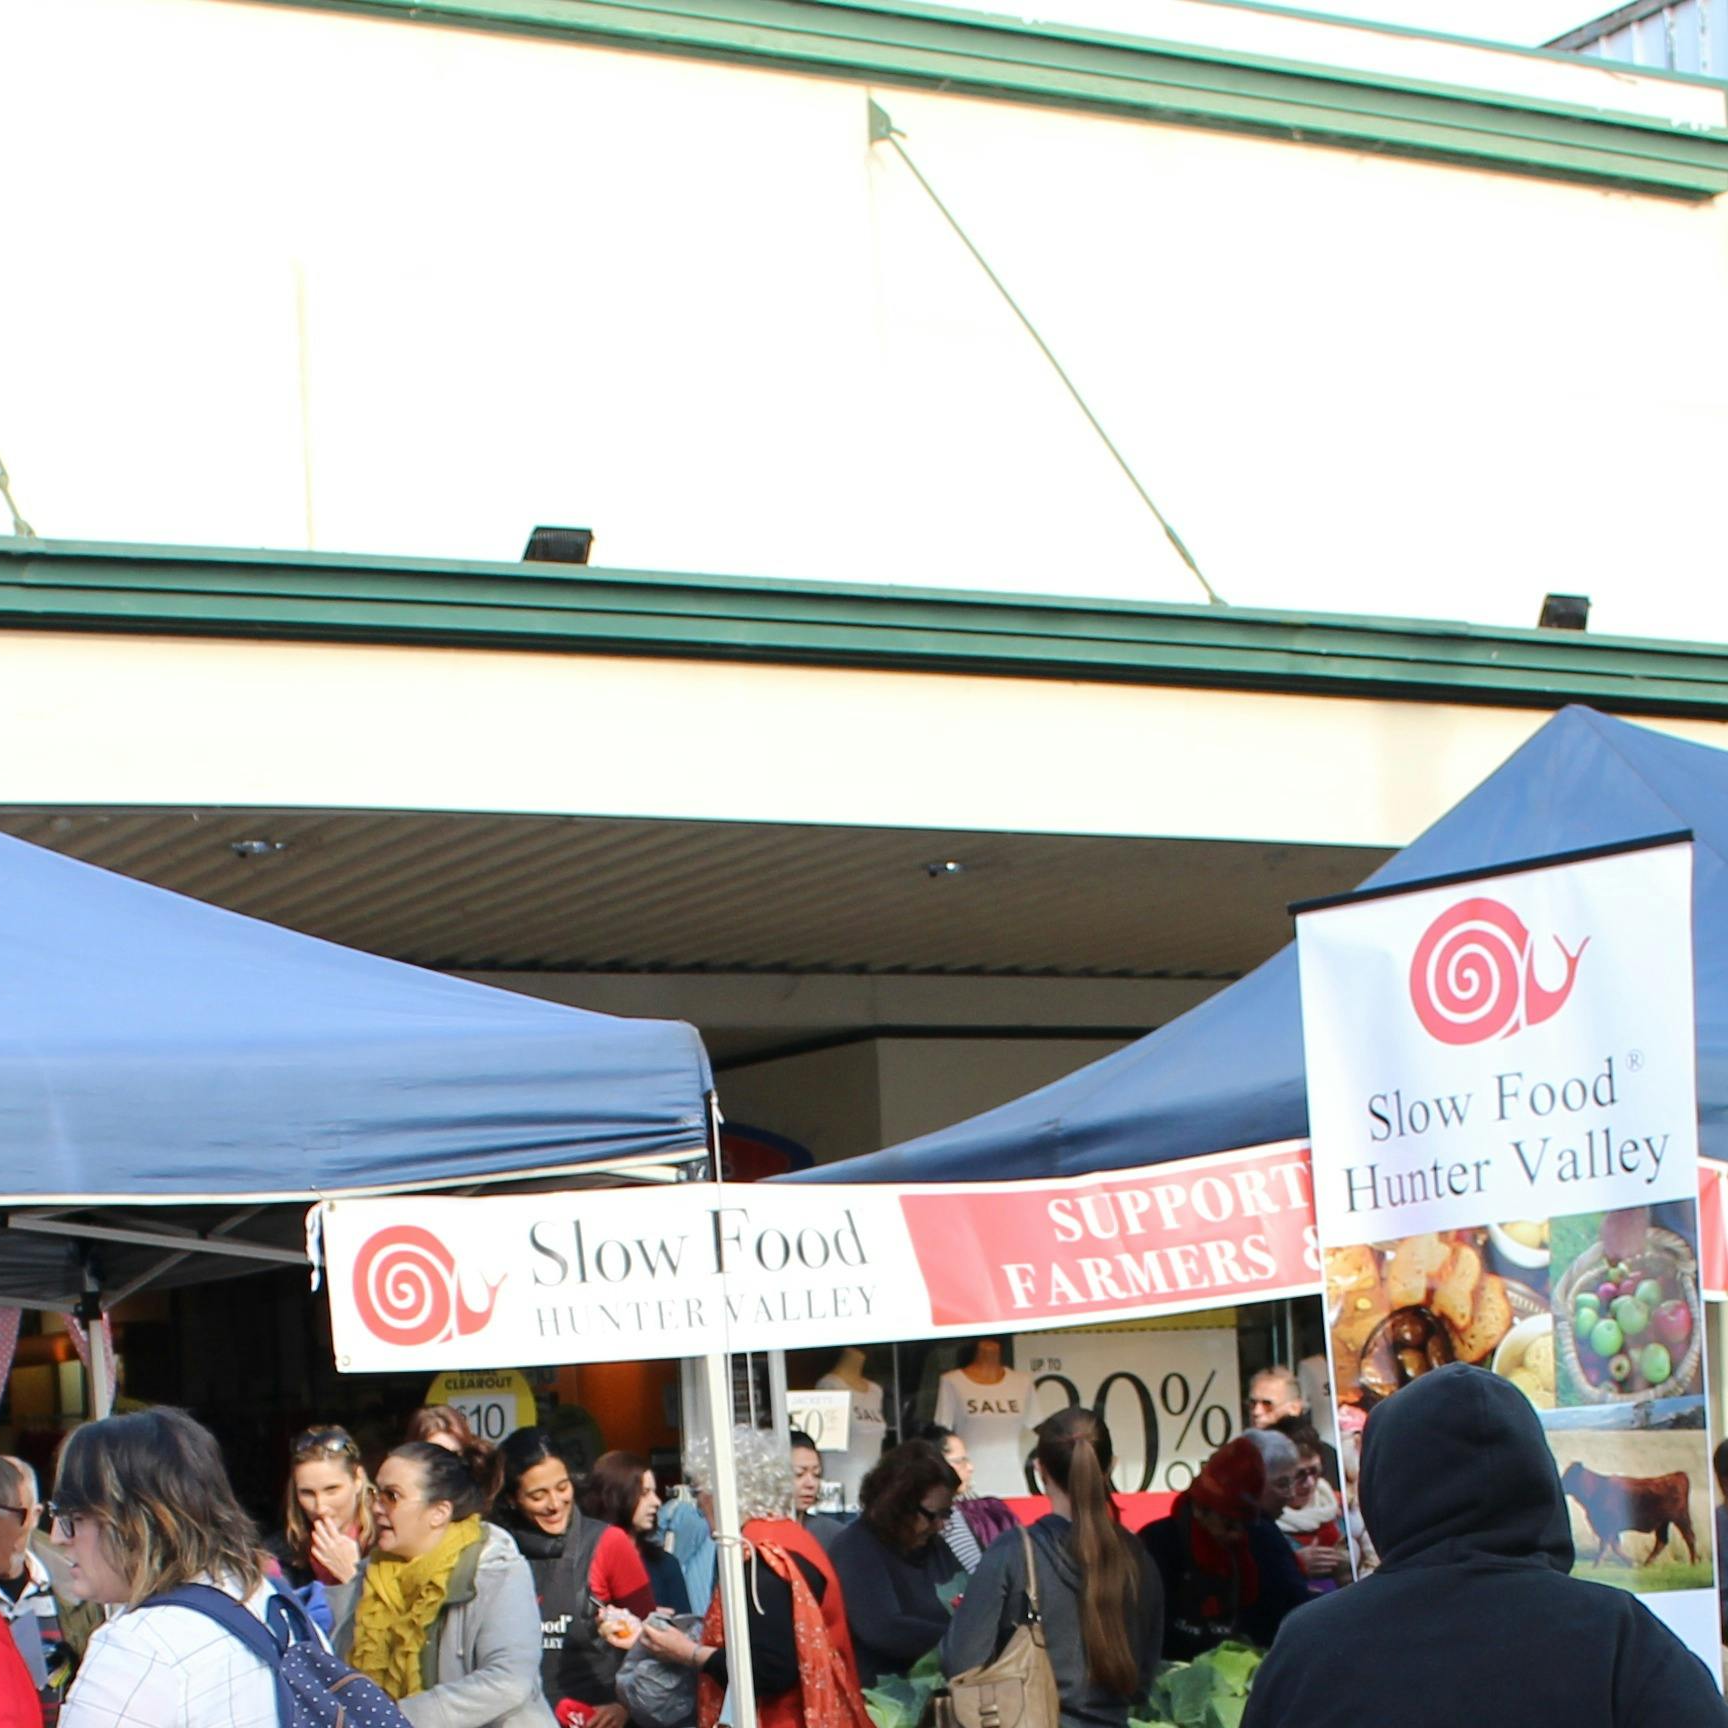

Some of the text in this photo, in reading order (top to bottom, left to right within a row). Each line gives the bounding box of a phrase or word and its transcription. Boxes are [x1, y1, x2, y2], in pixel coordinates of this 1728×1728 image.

[1368, 1056, 1618, 1142] Slow Food
[1047, 1161, 1311, 1243] SUPPORT
[1341, 1127, 1670, 1213] Hunter Valley
[528, 1208, 871, 1286] Slow Food
[1001, 1234, 1278, 1309] FARMERS
[536, 1285, 878, 1337] HUNTER VALLEY
[444, 1375, 513, 1391] CLEAROUT
[966, 1398, 1020, 1415] SALE
